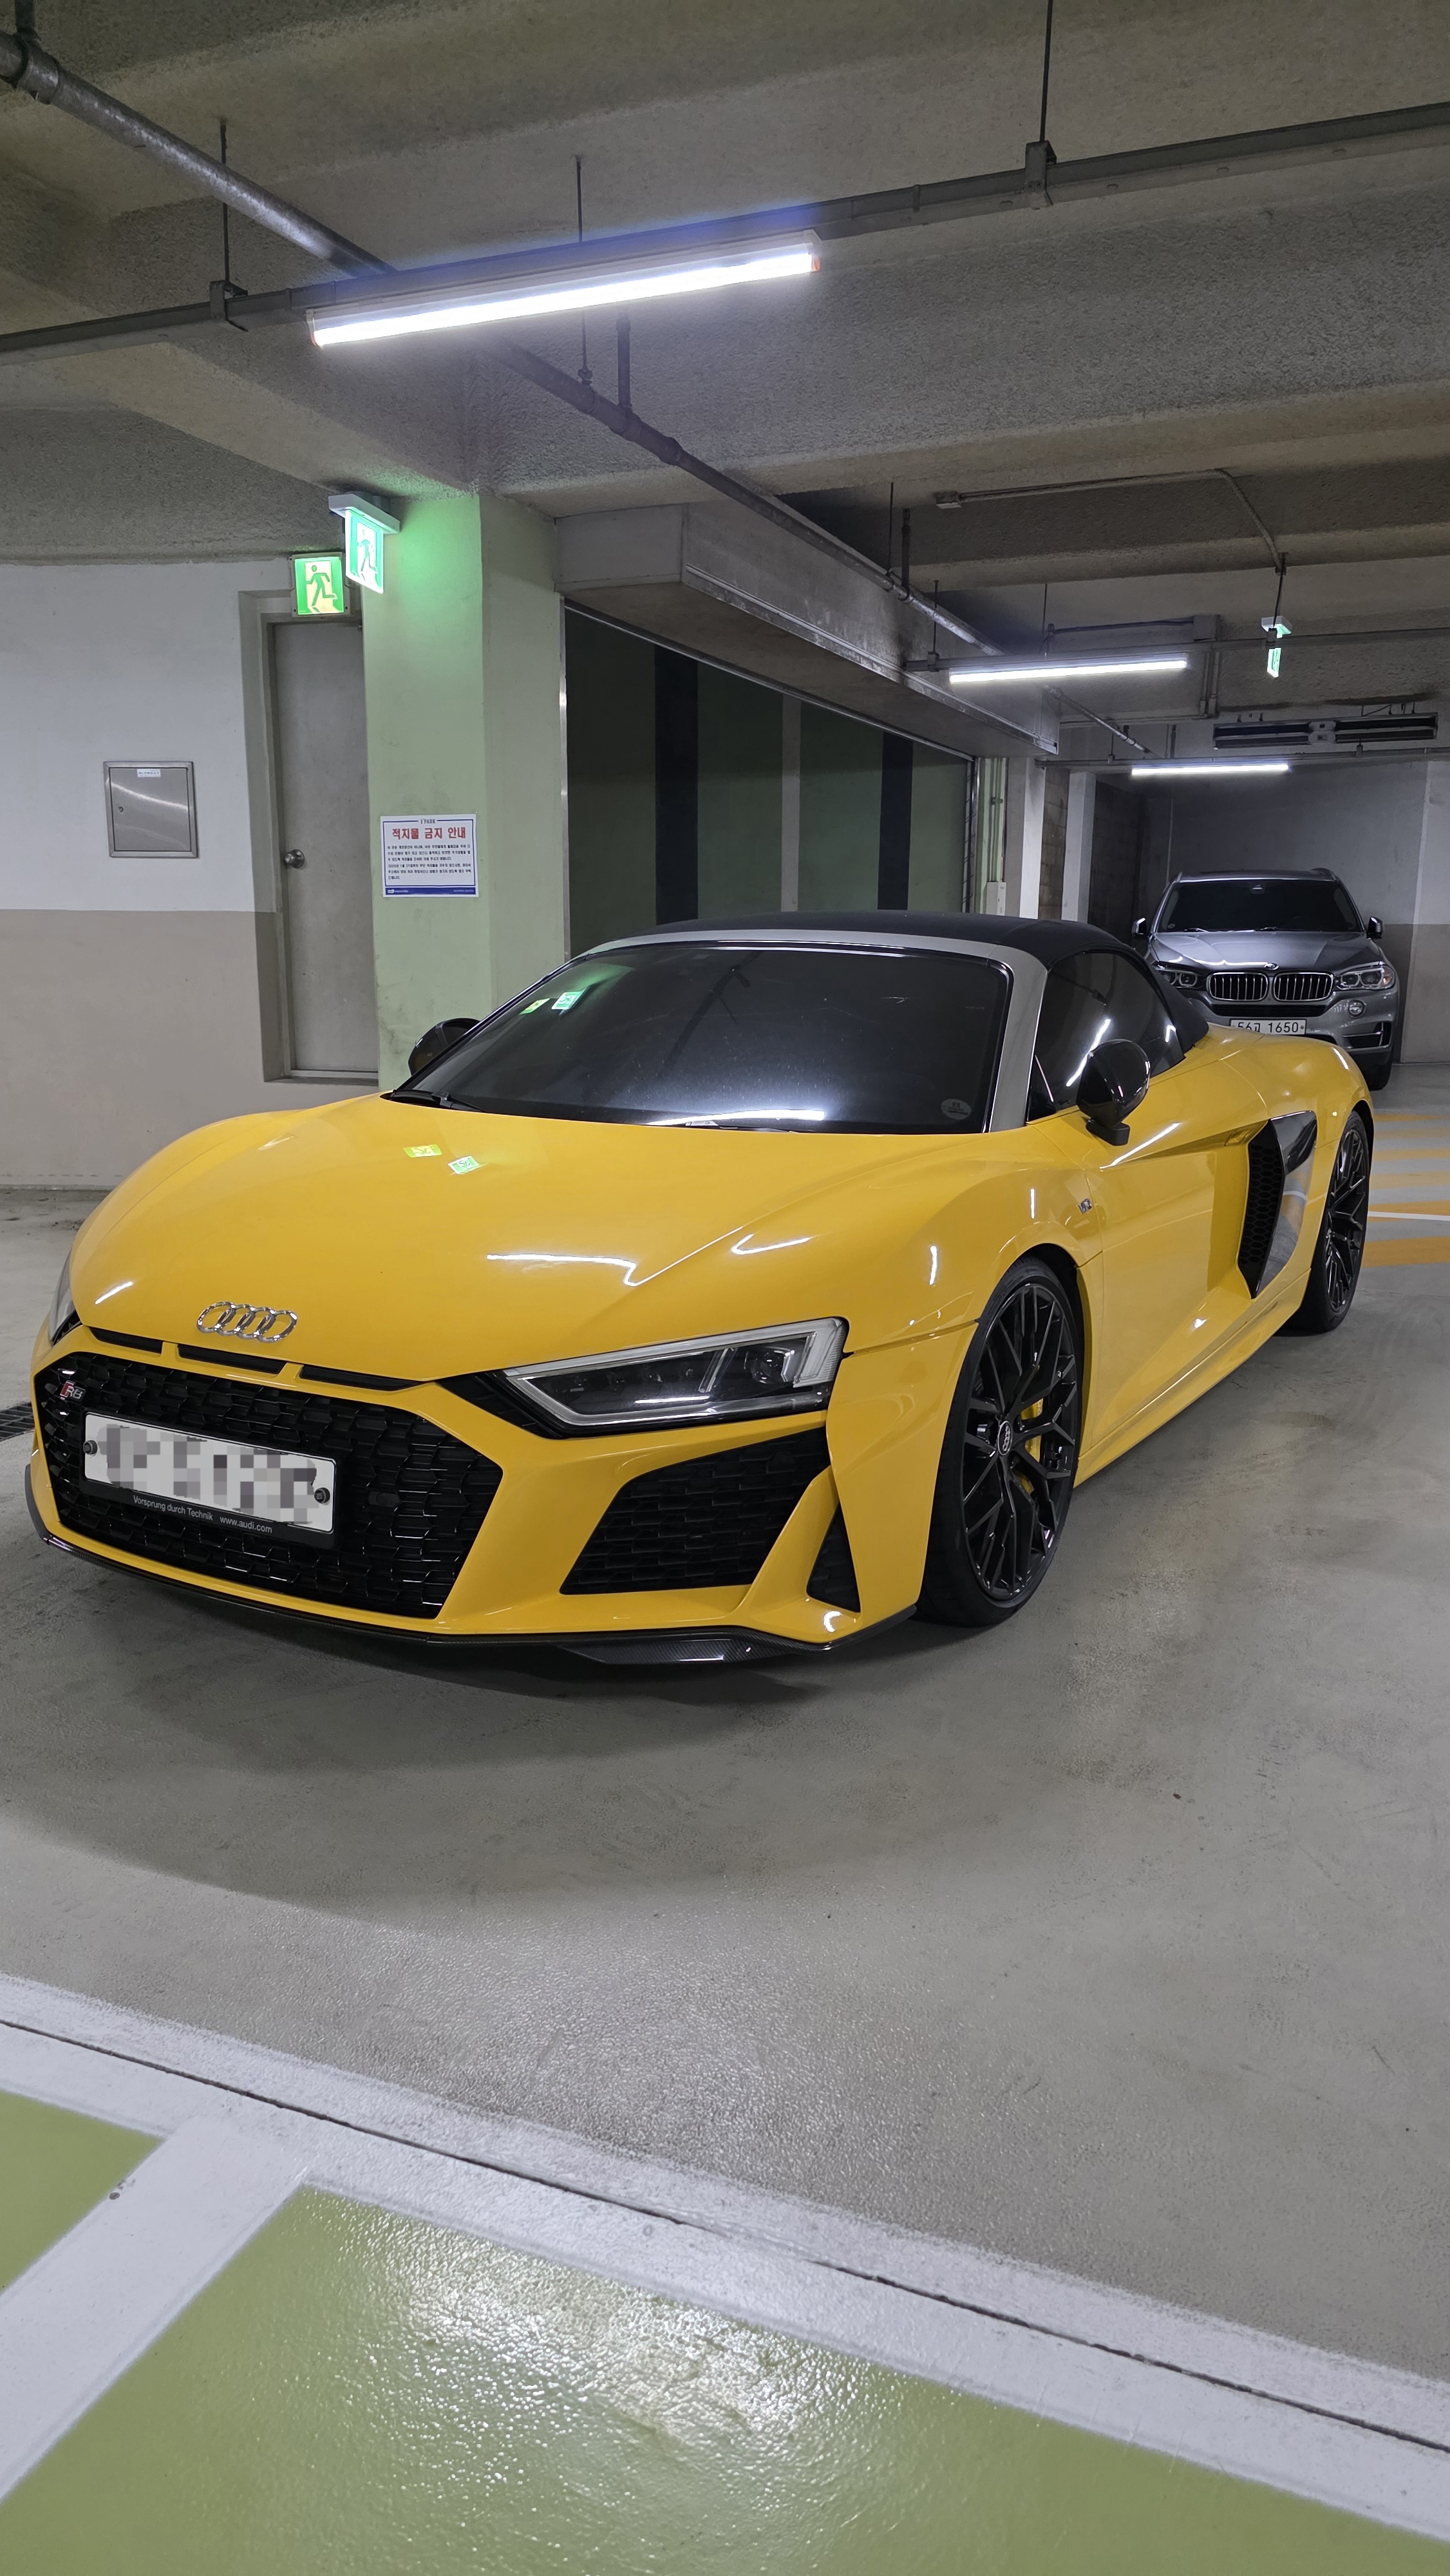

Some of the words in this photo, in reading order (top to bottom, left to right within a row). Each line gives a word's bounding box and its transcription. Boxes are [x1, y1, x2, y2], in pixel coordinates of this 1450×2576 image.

[392, 828, 419, 840] 적치물
[424, 828, 442, 839] 금지
[447, 827, 466, 838] 안내
[1268, 1021, 1299, 1033] 1650
[62, 1384, 83, 1399] R8
[133, 1495, 166, 1511] Vorsprung
[167, 1504, 186, 1515] durch
[187, 1508, 213, 1521] Technik
[220, 1517, 272, 1533] www.audi.com
